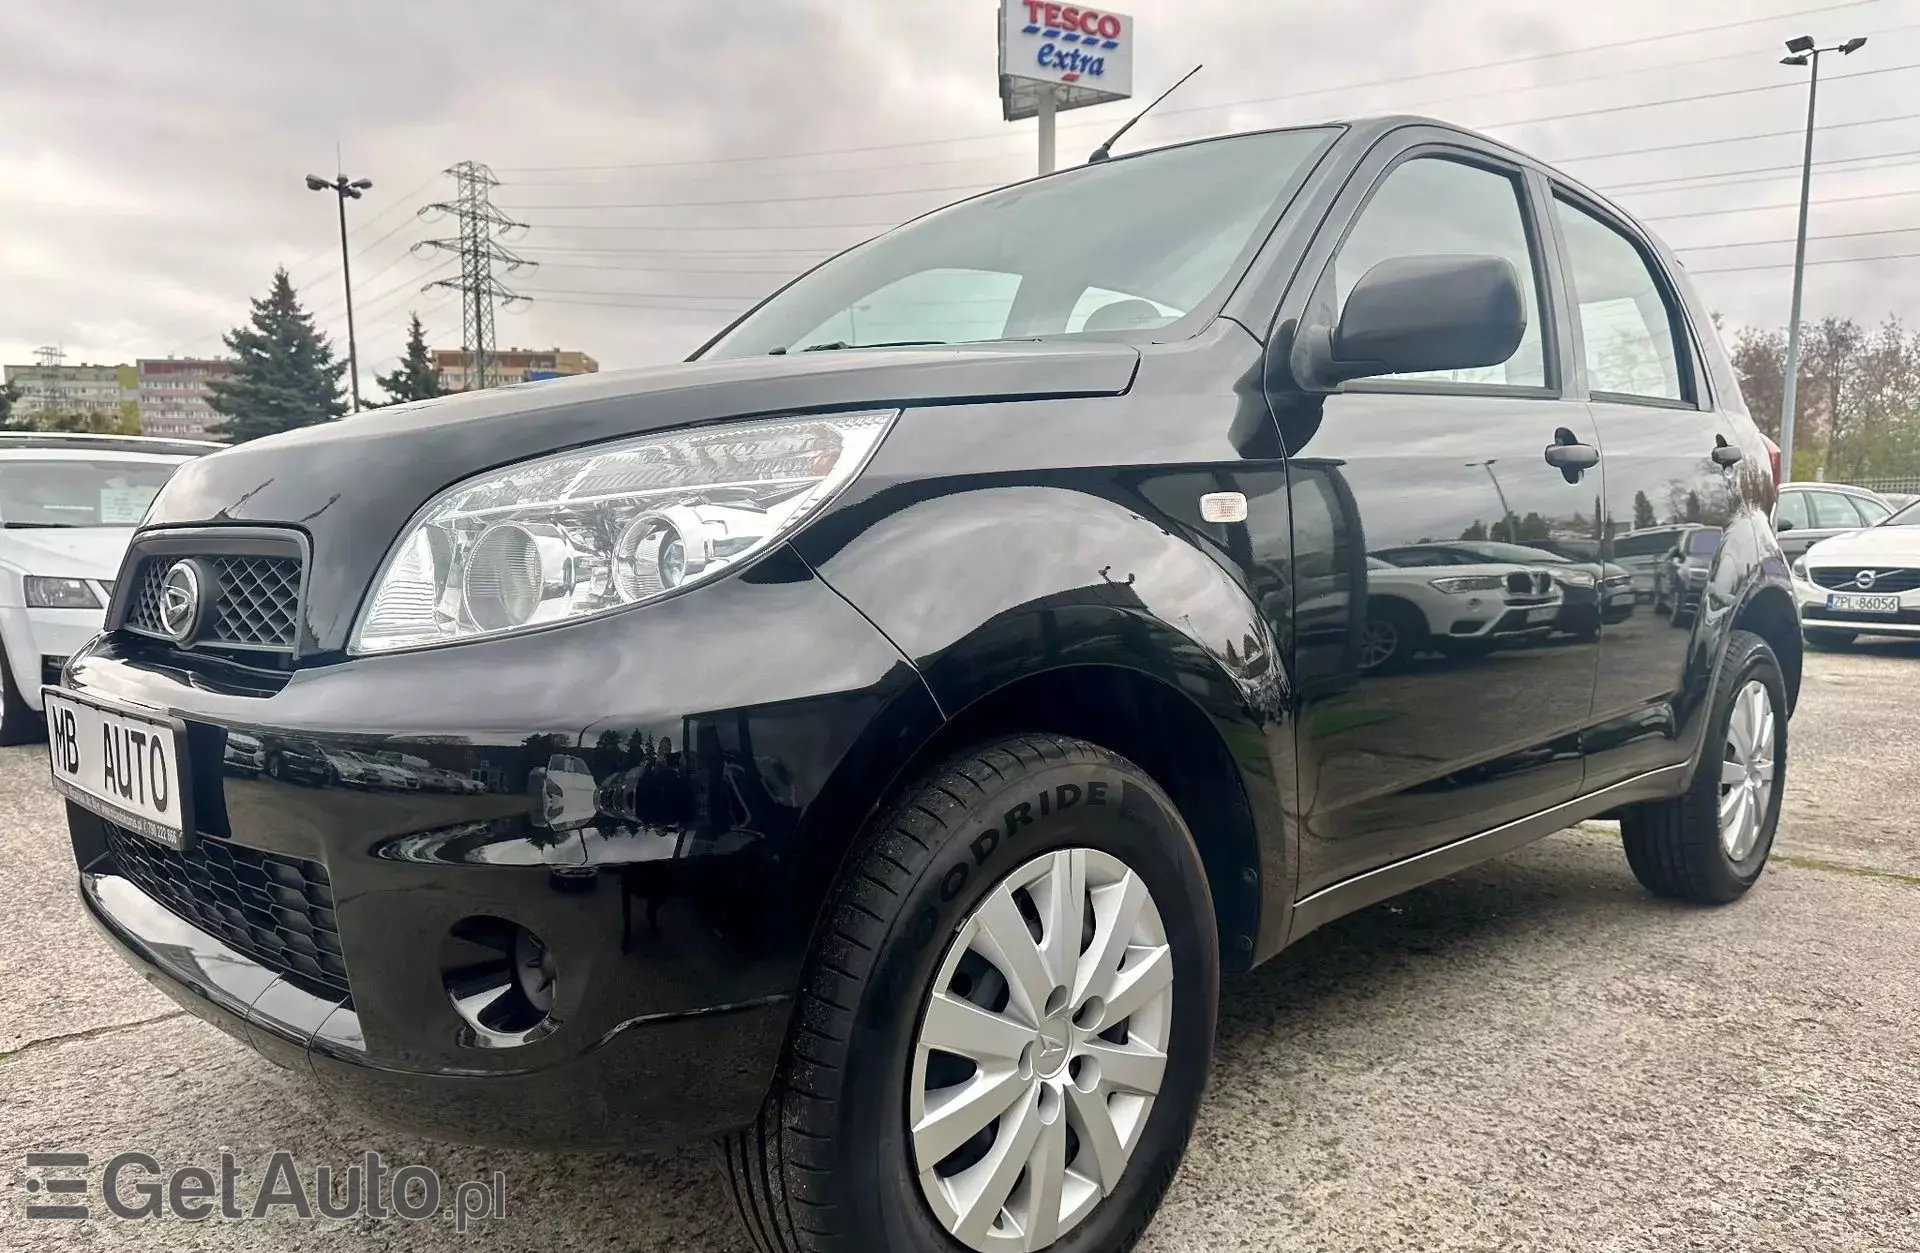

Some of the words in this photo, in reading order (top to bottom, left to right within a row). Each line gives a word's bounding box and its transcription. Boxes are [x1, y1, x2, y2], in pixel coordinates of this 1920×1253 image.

[1022, 0, 1121, 39] TESCO
[1037, 43, 1105, 76] extra
[1859, 597, 1896, 610] 86056
[52, 704, 79, 775] MB
[103, 722, 168, 813] AUTO
